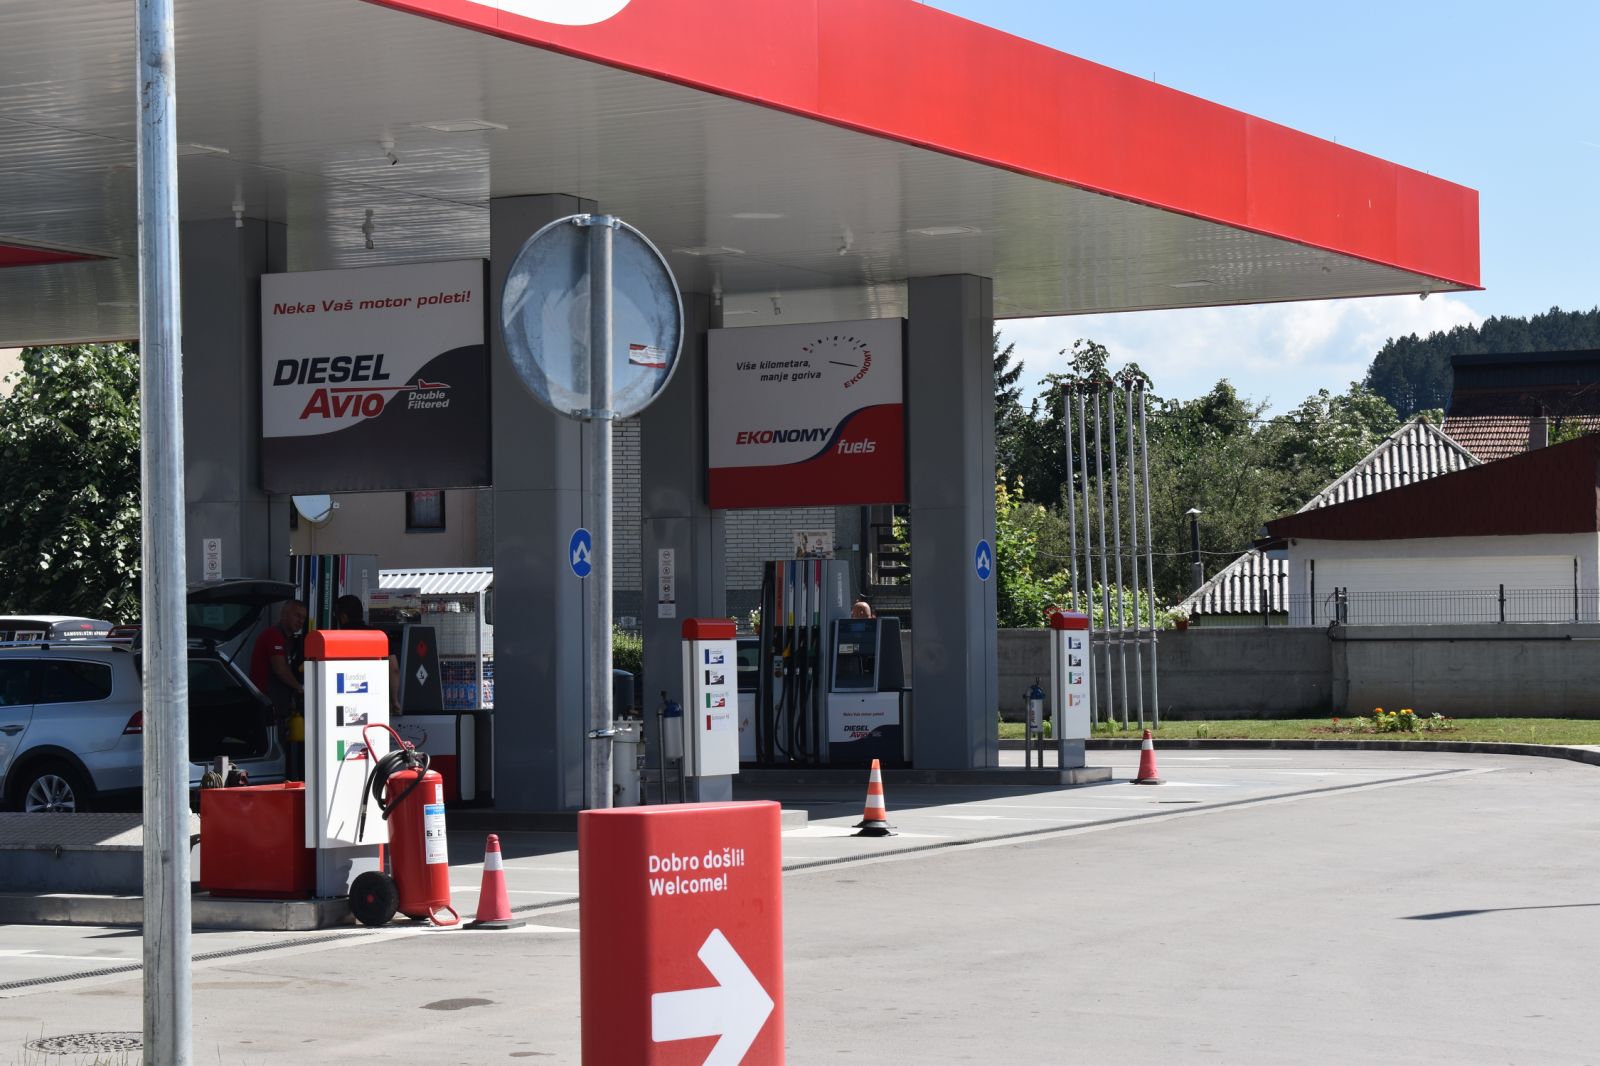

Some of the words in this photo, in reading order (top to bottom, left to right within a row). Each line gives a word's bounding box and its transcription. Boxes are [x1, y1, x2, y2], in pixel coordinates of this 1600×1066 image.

[273, 303, 316, 315] Neka
[322, 300, 353, 312] Vaš
[359, 296, 412, 310] motor
[416, 291, 471, 308] poleti!
[273, 354, 390, 386] DIESEL
[736, 361, 757, 371] Više
[759, 360, 811, 370] kilometara,
[844, 349, 872, 388] EKONOMY
[760, 372, 788, 382] manje
[791, 371, 822, 381] goriva
[407, 399, 449, 409] Filtered
[408, 391, 445, 400] Double
[736, 427, 832, 445] EKONOMY
[837, 438, 876, 454] fuels
[649, 852, 699, 872] Dobro
[703, 847, 744, 869] došli!
[649, 872, 728, 896] Welcome!
